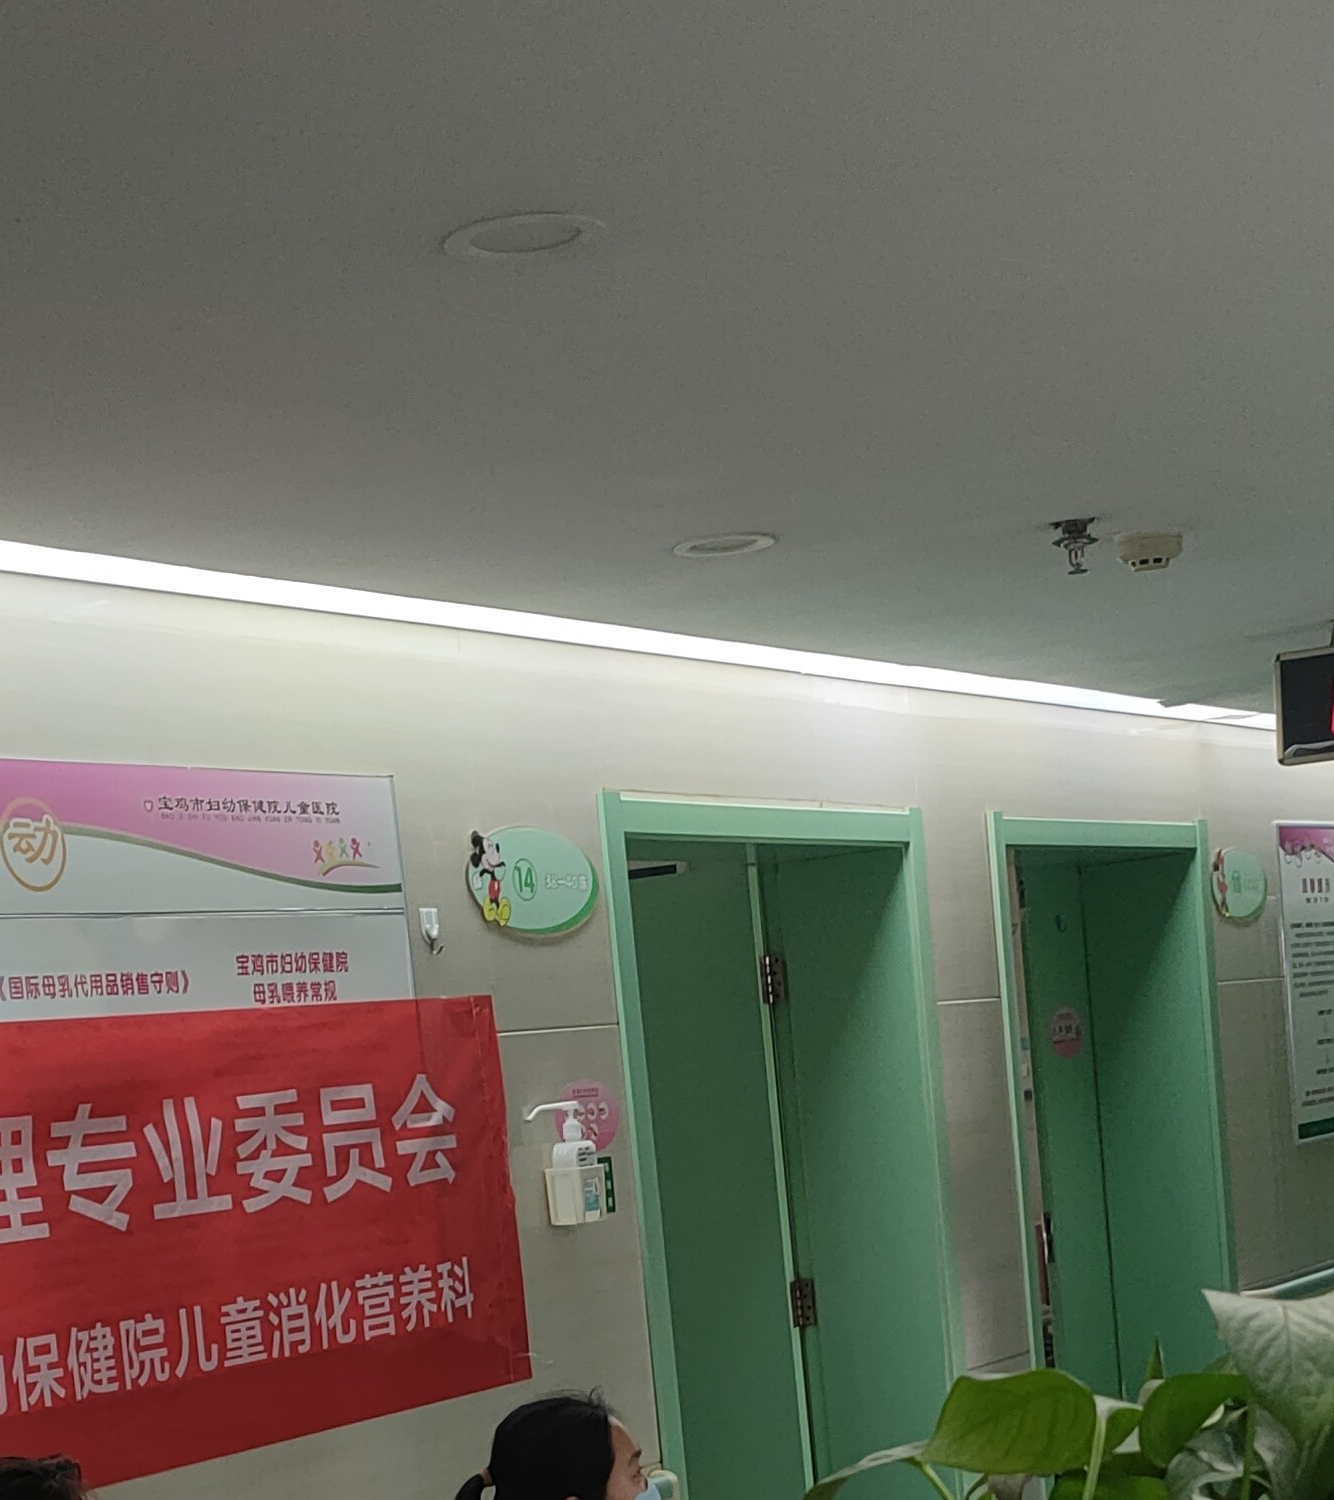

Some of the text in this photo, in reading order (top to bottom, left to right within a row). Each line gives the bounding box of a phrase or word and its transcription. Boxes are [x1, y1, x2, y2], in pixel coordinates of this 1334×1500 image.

[158, 795, 340, 815] 宝鸡市妇幼保健院儿童医院
[514, 866, 535, 893] 14
[235, 951, 349, 976] 宝鸡市妇幼保健院
[253, 980, 338, 1005] 母乳喂养常规
